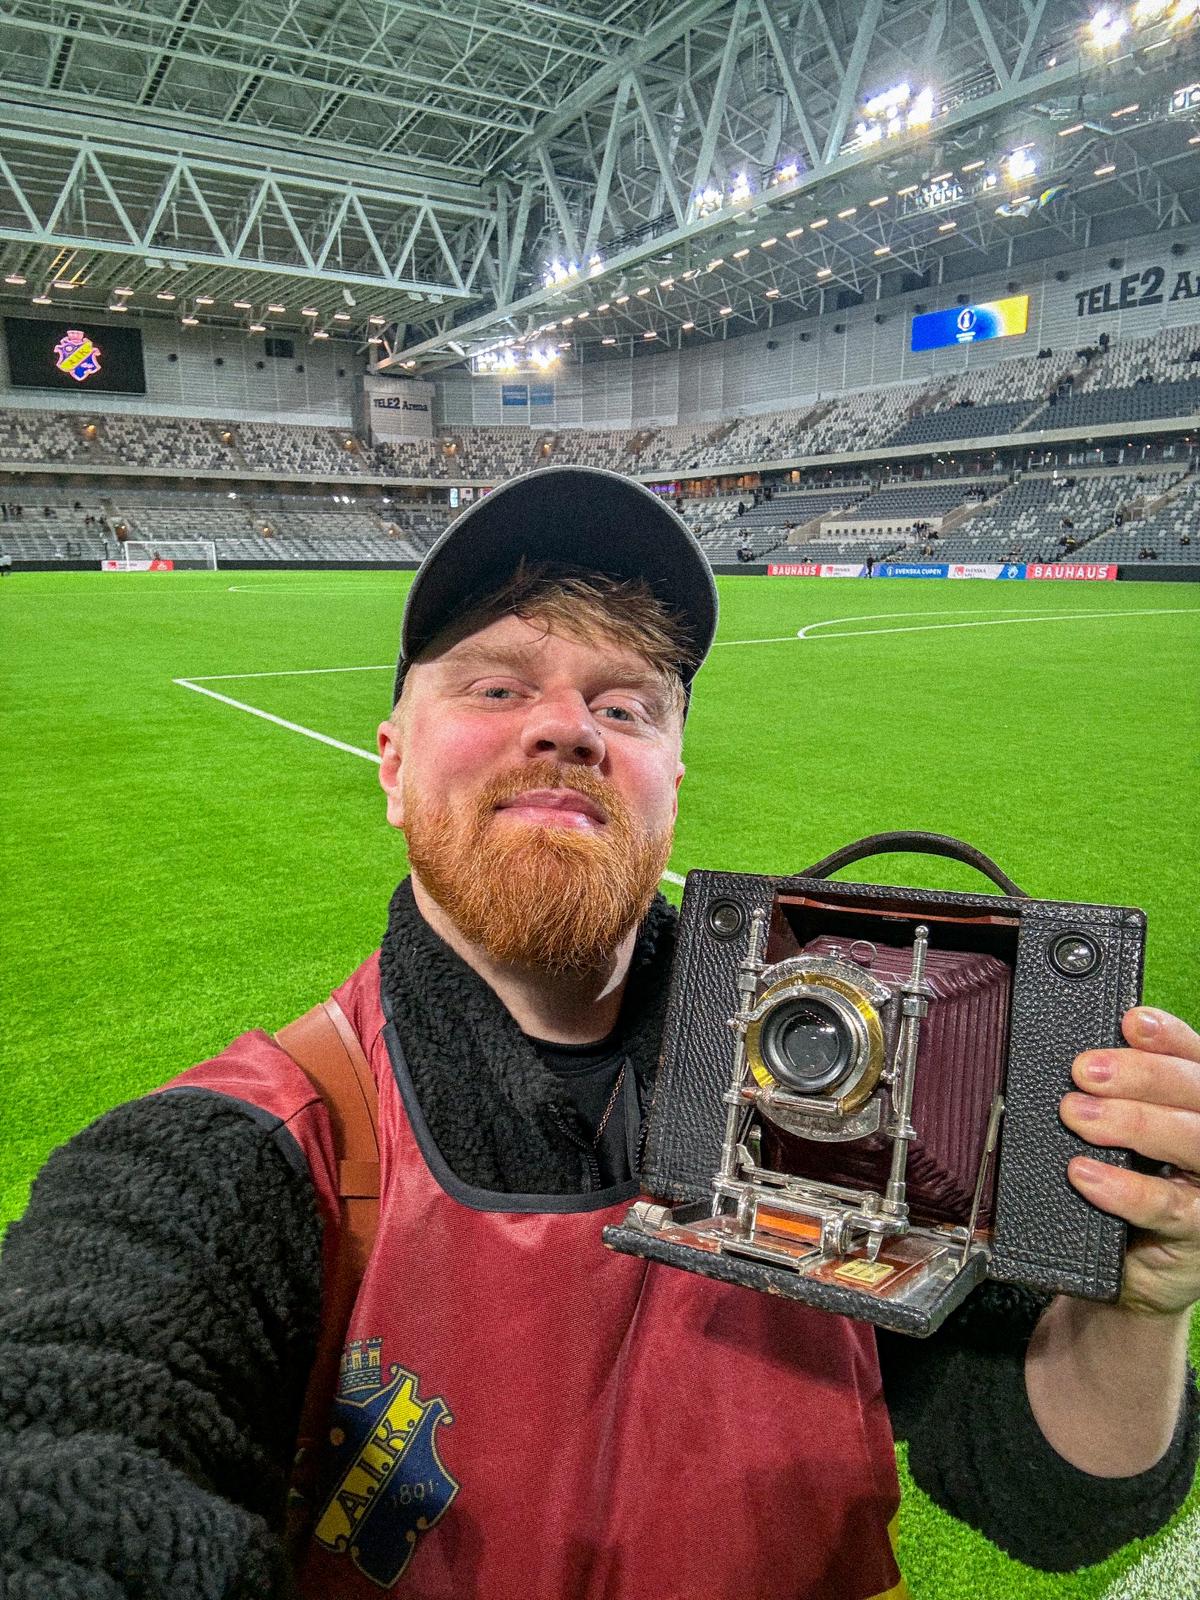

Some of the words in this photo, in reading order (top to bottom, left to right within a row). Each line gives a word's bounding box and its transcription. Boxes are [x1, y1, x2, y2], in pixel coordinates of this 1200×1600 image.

[1075, 266, 1165, 316] TELE2
[374, 397, 400, 410] TELE2
[402, 401, 428, 411] Arena
[773, 566, 816, 576] BAUHAUS
[1034, 566, 1108, 578] BAUHAUS
